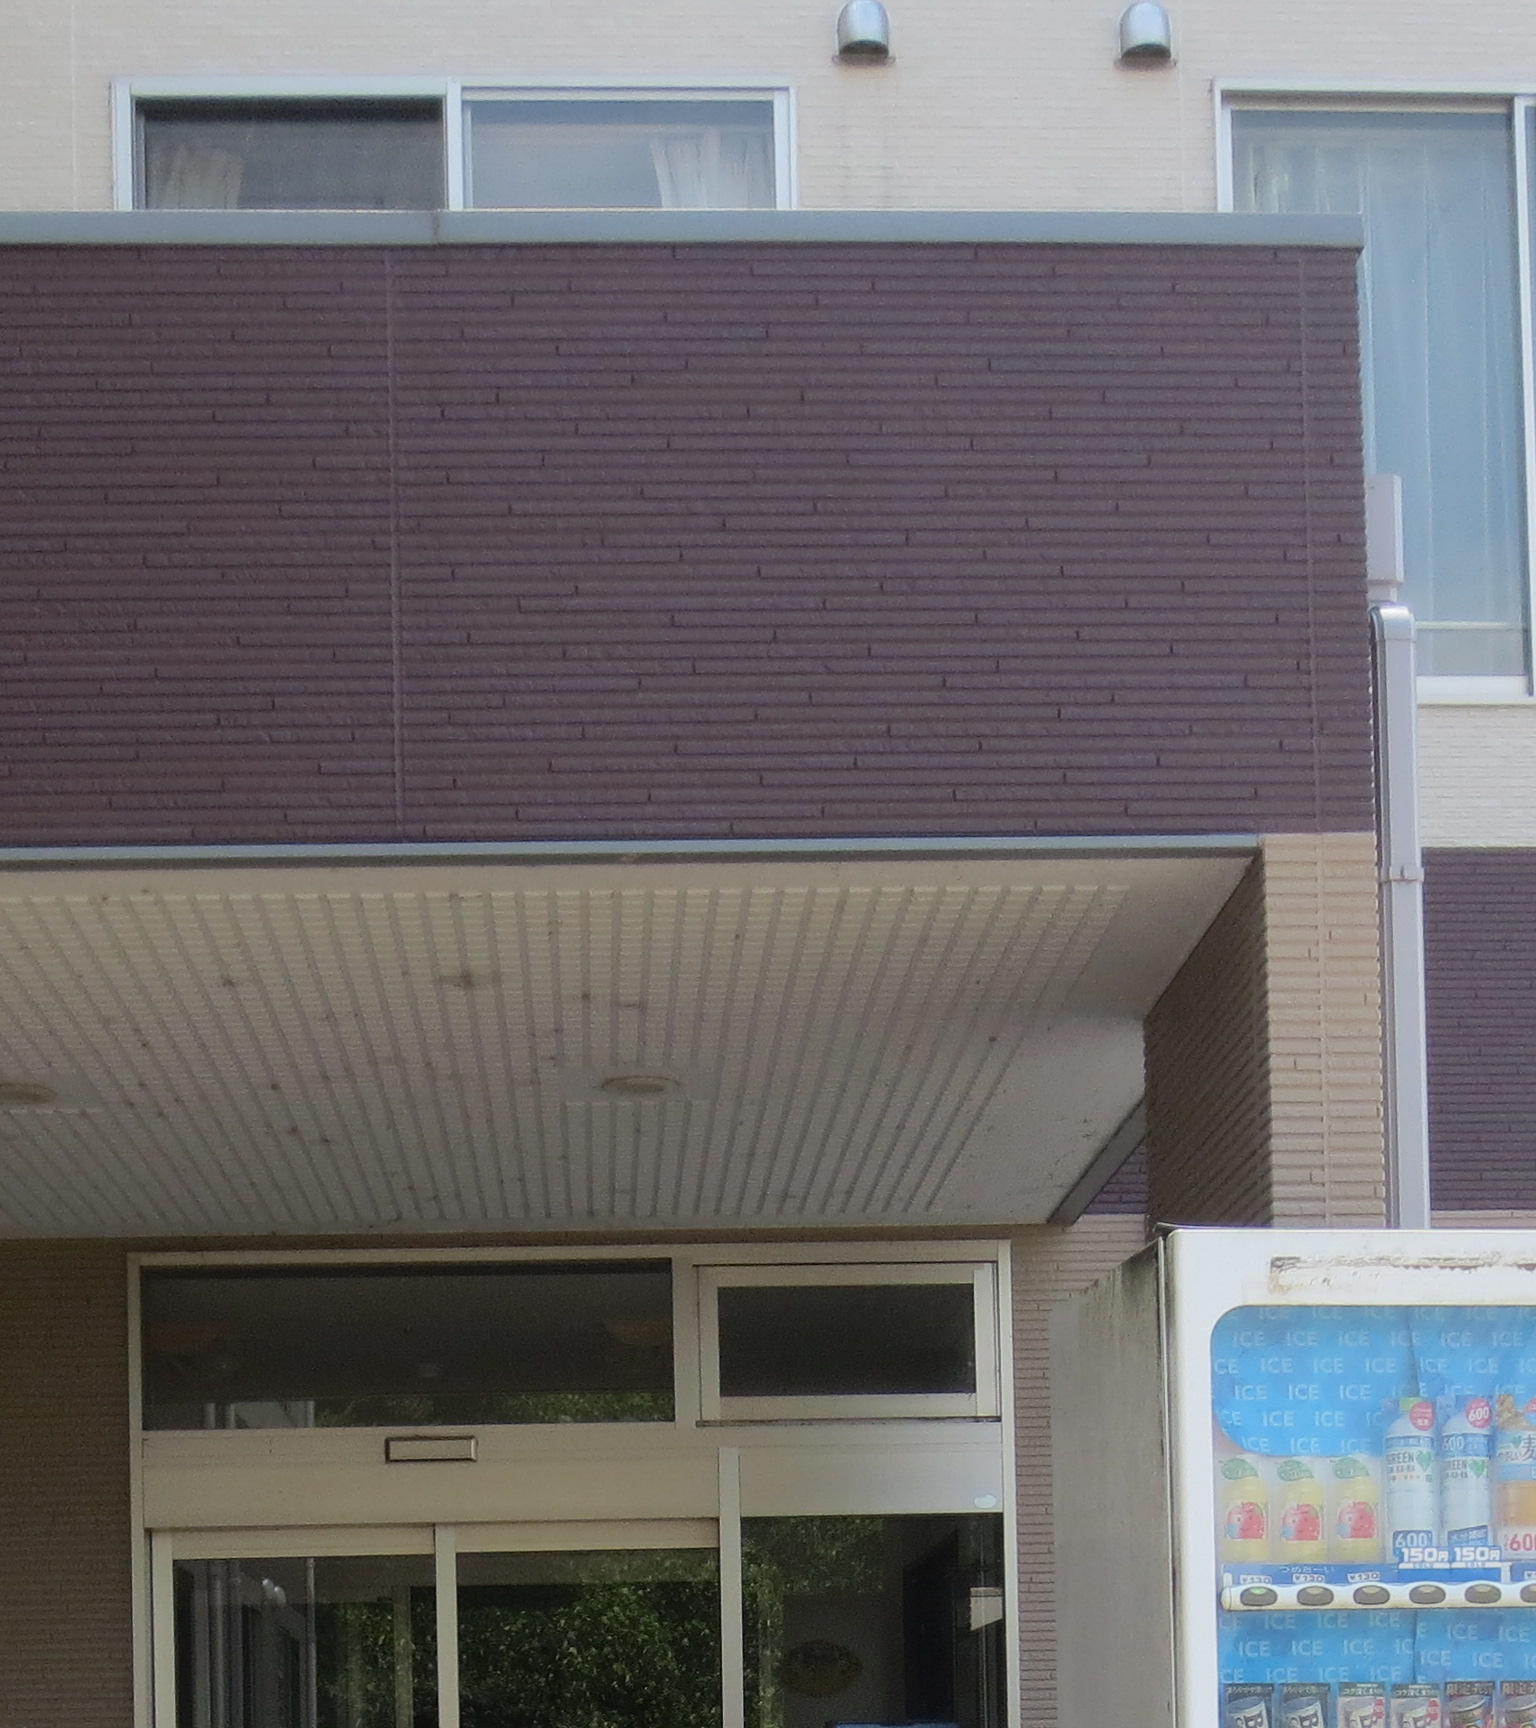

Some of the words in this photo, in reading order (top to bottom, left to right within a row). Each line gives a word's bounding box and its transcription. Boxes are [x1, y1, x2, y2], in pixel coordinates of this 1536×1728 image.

[1233, 1331, 1264, 1347] ICE
[1287, 1331, 1318, 1346] ICE
[1338, 1331, 1369, 1346] ICE
[1441, 1332, 1472, 1347] ICE
[1214, 1359, 1239, 1375] CE
[1261, 1358, 1294, 1374] ICE
[1314, 1358, 1345, 1374] ICE
[1366, 1358, 1397, 1374] ICE
[1468, 1358, 1499, 1374] ICE
[1235, 1384, 1267, 1400] ICE
[1289, 1384, 1320, 1400] ICE
[1339, 1384, 1371, 1400] ICE
[1265, 1411, 1296, 1427] ICE
[1315, 1411, 1346, 1427] ICE
[1468, 1406, 1490, 1421] 600
[1290, 1437, 1322, 1454] ICE
[1395, 1534, 1428, 1549] 600
[1402, 1547, 1449, 1562] 150円
[1454, 1546, 1500, 1561] 150円
[1219, 1614, 1242, 1630] CE
[1317, 1613, 1348, 1628] ICE
[1369, 1612, 1400, 1628] ICE
[1447, 1624, 1479, 1640] ICE
[1498, 1626, 1530, 1643] ICE
[1238, 1641, 1270, 1657] ICE
[1292, 1640, 1324, 1656] ICE
[1343, 1639, 1374, 1655] ICE
[1421, 1650, 1452, 1666] ICE
[1221, 1668, 1244, 1683] CE
[1266, 1668, 1298, 1683] ICE
[1319, 1667, 1349, 1682] ICE
[1370, 1666, 1401, 1682] ICE
